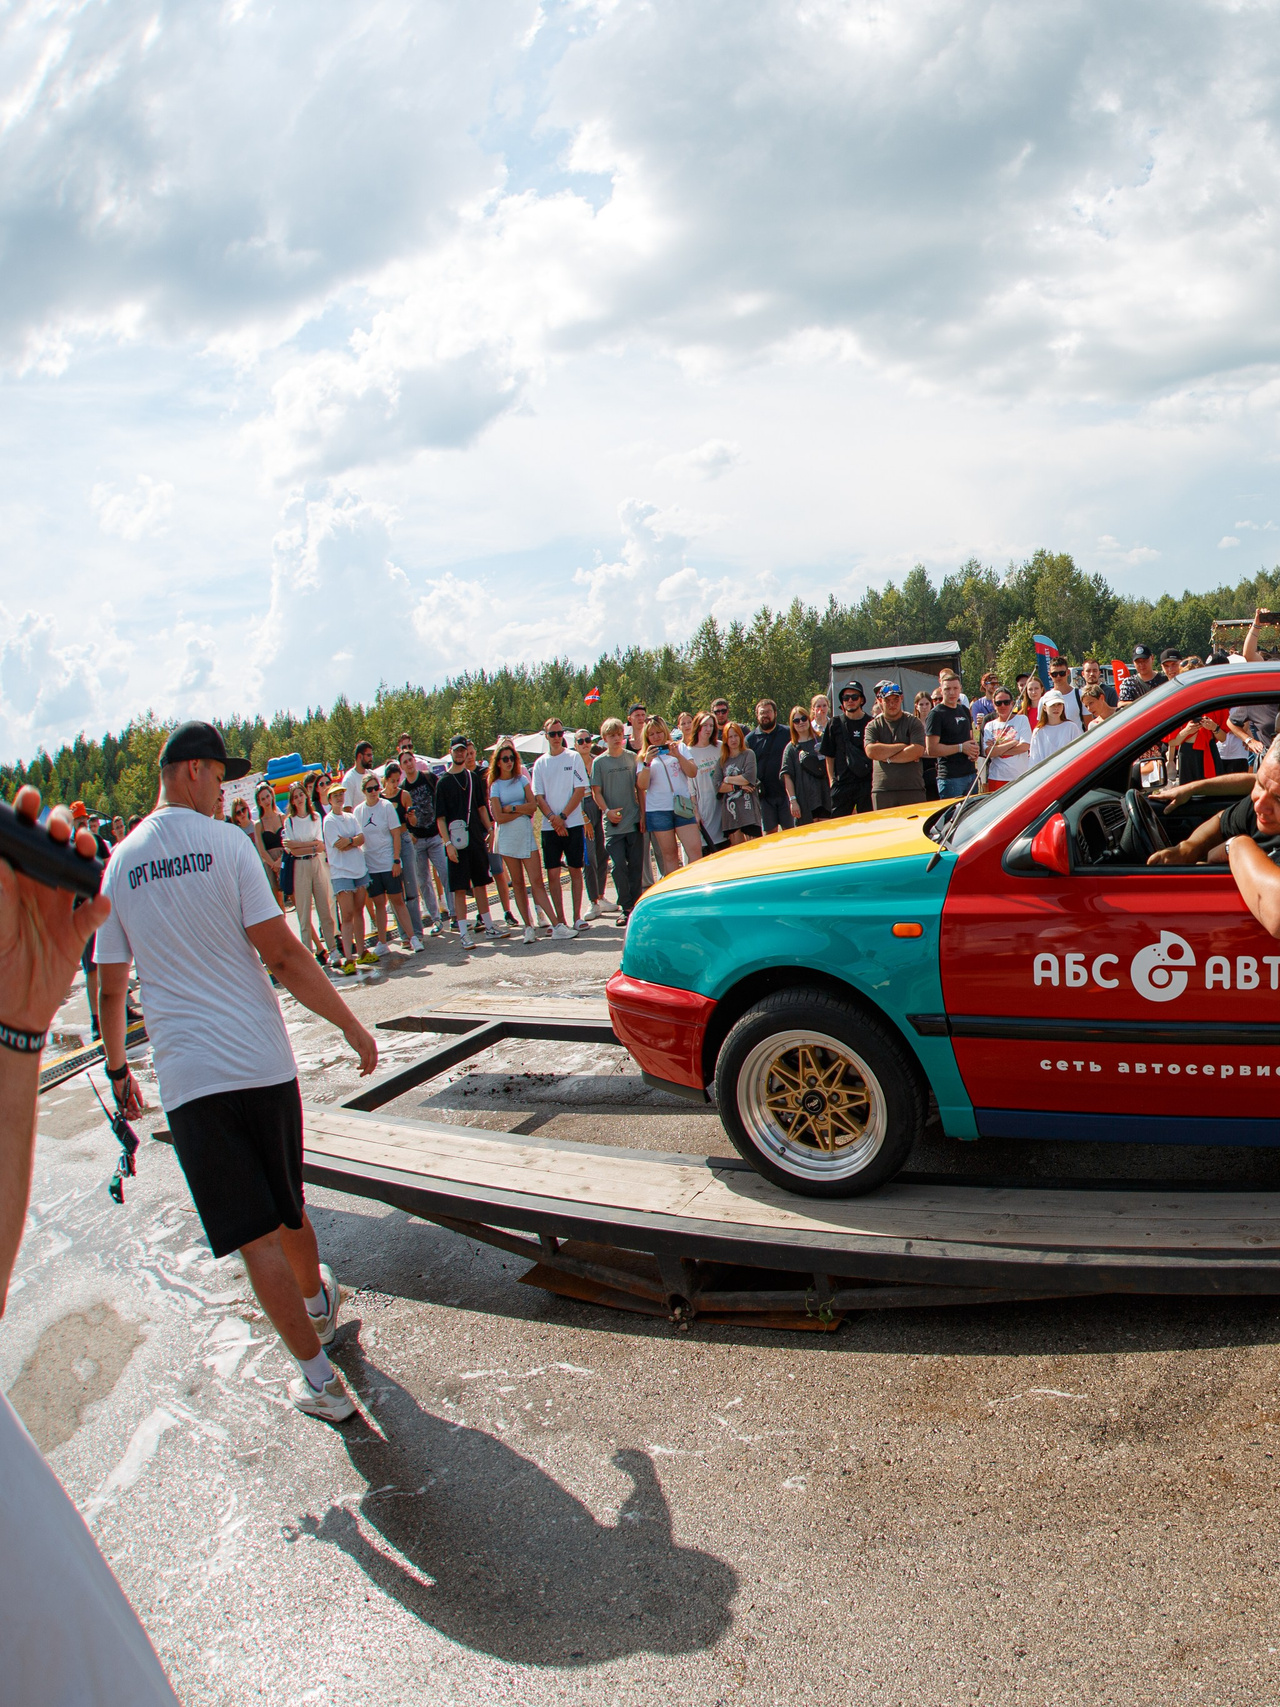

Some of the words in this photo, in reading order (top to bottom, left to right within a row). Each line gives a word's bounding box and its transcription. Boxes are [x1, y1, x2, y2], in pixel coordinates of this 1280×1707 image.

[128, 852, 213, 890] ОРГАНИЗАТОР
[1033, 953, 1120, 989] АБС
[1040, 1059, 1102, 1073] сеть
